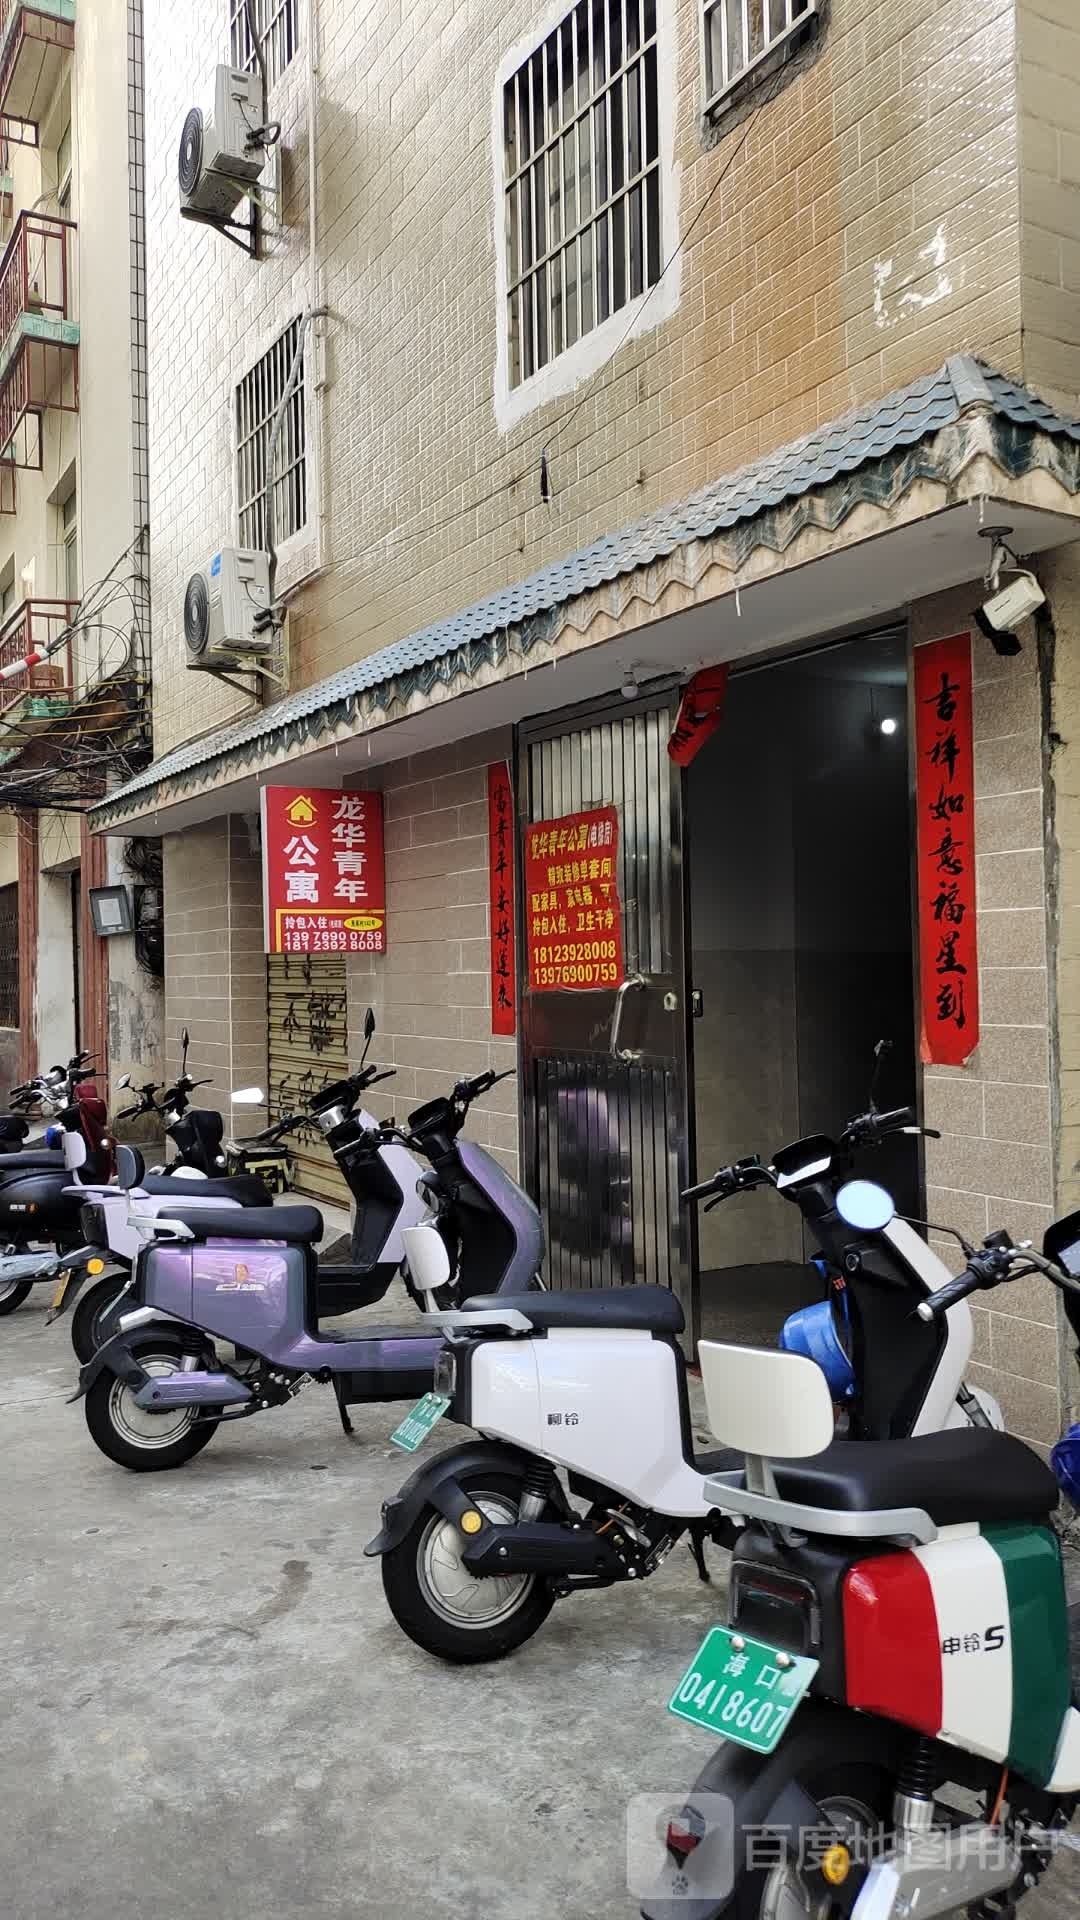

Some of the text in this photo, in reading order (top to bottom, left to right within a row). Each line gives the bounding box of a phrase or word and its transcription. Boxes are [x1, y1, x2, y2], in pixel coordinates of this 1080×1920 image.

[331, 795, 369, 903] 龙华青年
[924, 672, 968, 1030] 吉祥如意福星到
[283, 835, 320, 903] 公寓
[285, 931, 382, 941] 139 7690 0759
[285, 941, 308, 951] 181
[350, 941, 383, 950] 8008
[534, 940, 616, 964] 18123928008
[534, 963, 617, 985] 13976900759
[722, 1653, 781, 1690] 海口
[679, 1672, 791, 1739] 0418607
